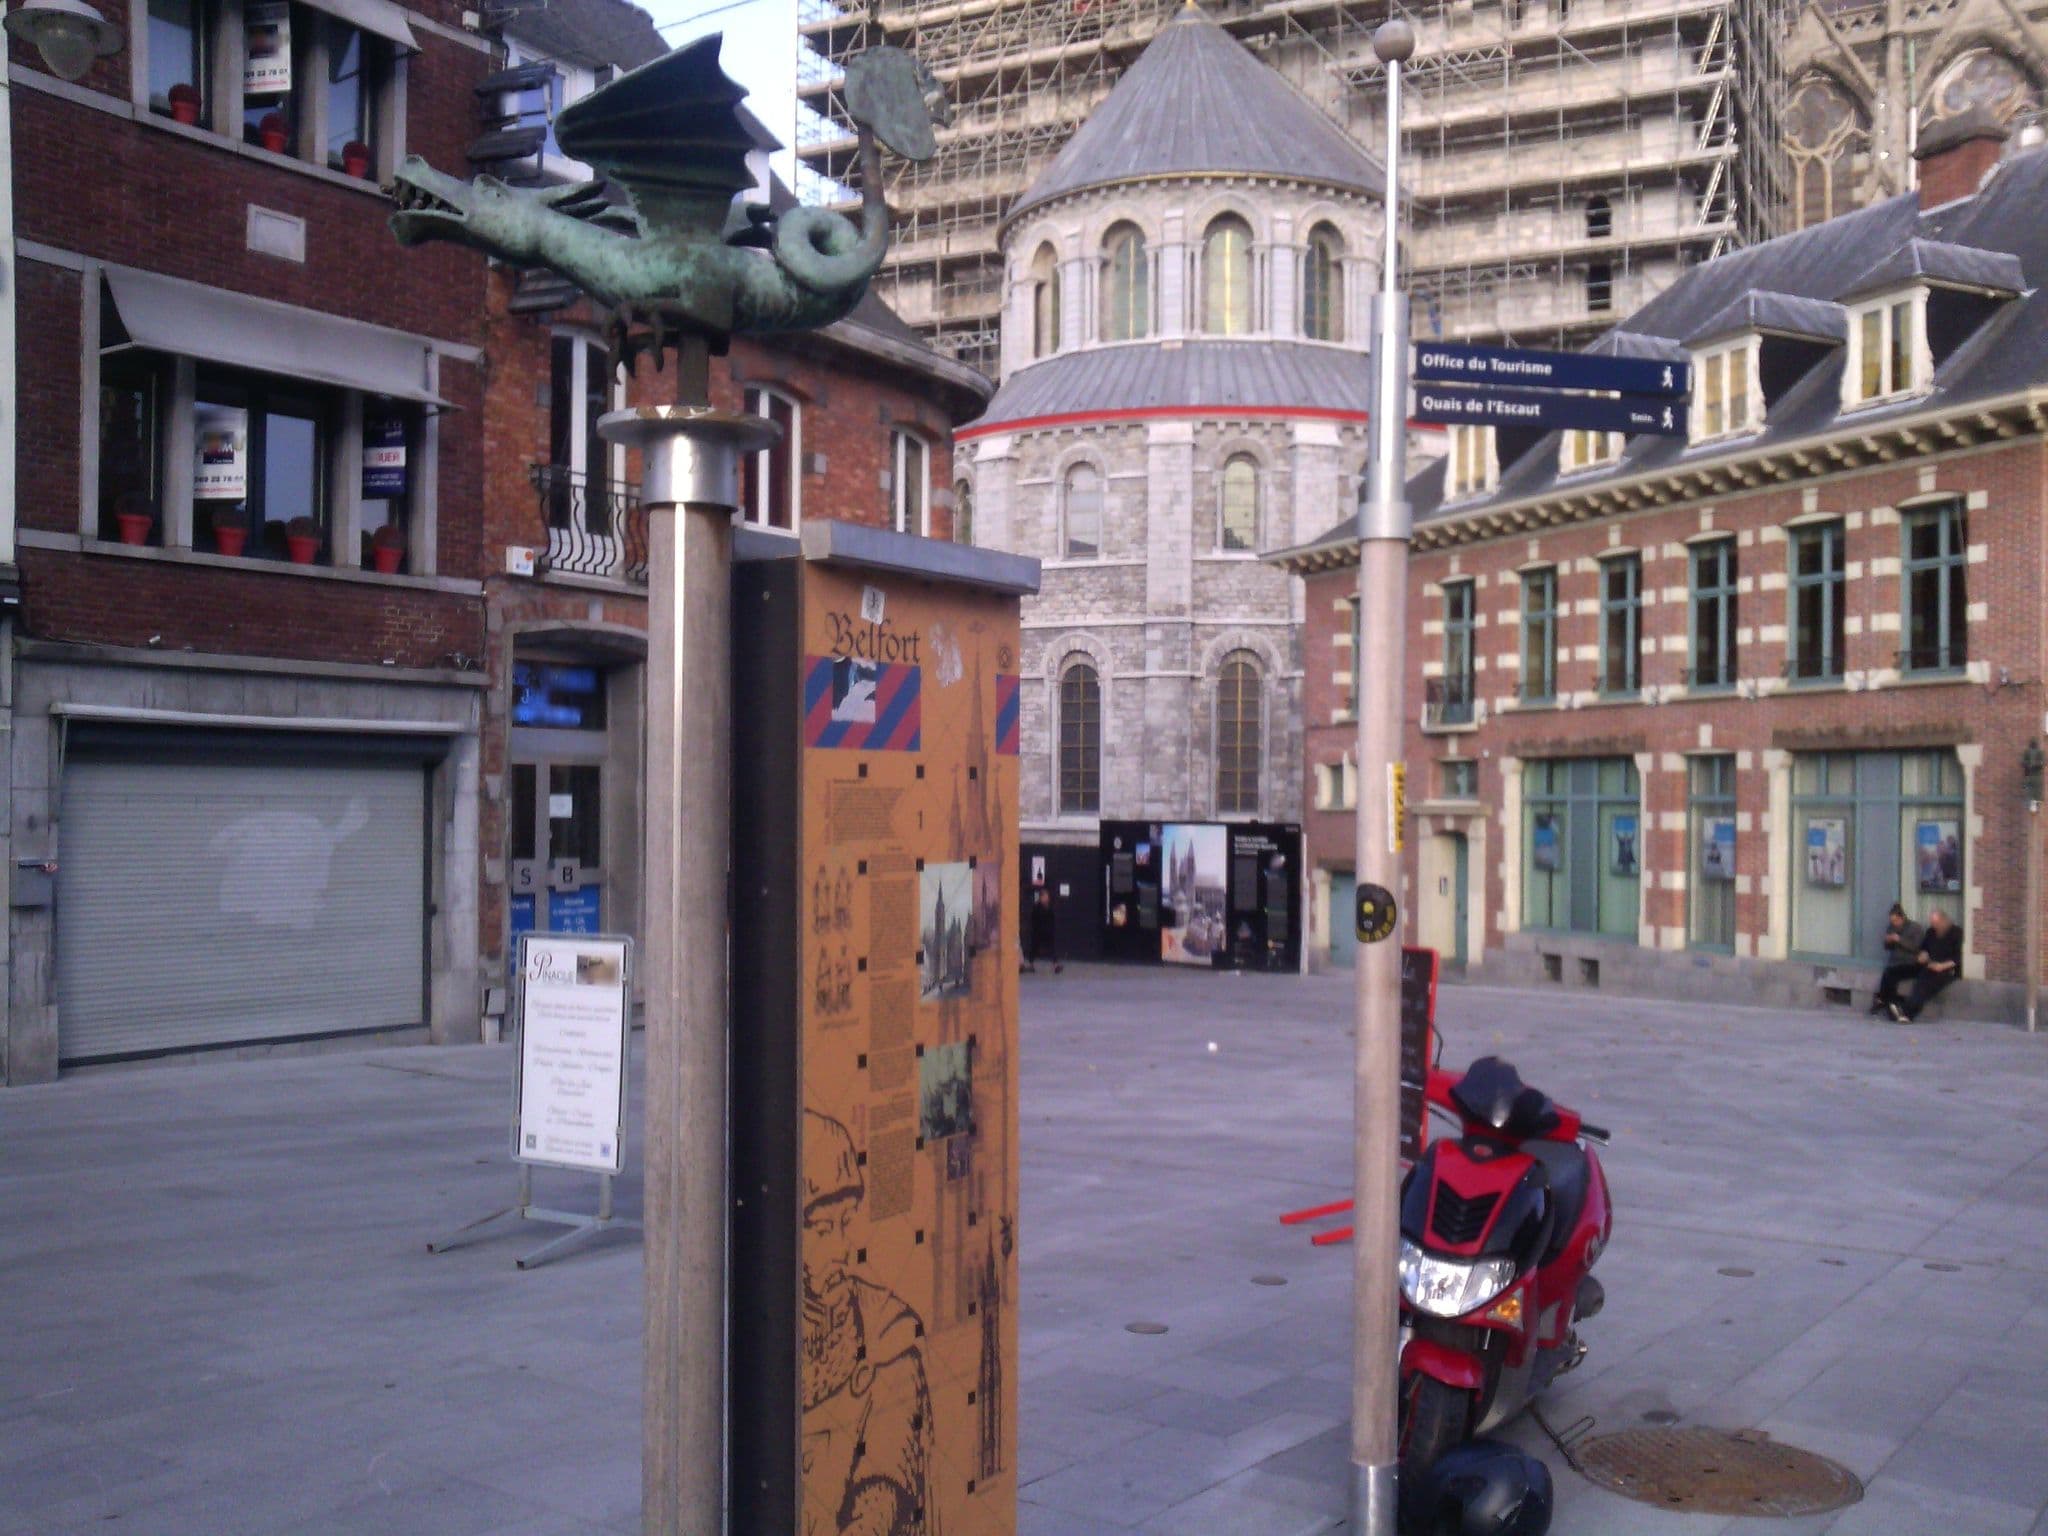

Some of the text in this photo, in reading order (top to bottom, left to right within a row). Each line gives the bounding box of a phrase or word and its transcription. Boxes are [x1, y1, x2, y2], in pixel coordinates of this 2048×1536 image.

[1422, 353, 1553, 375] Office du Tourisme
[1422, 396, 1541, 416] Quais de l'Escaut
[825, 611, 920, 664] Belfort
[520, 867, 531, 886] S
[562, 866, 573, 884] B
